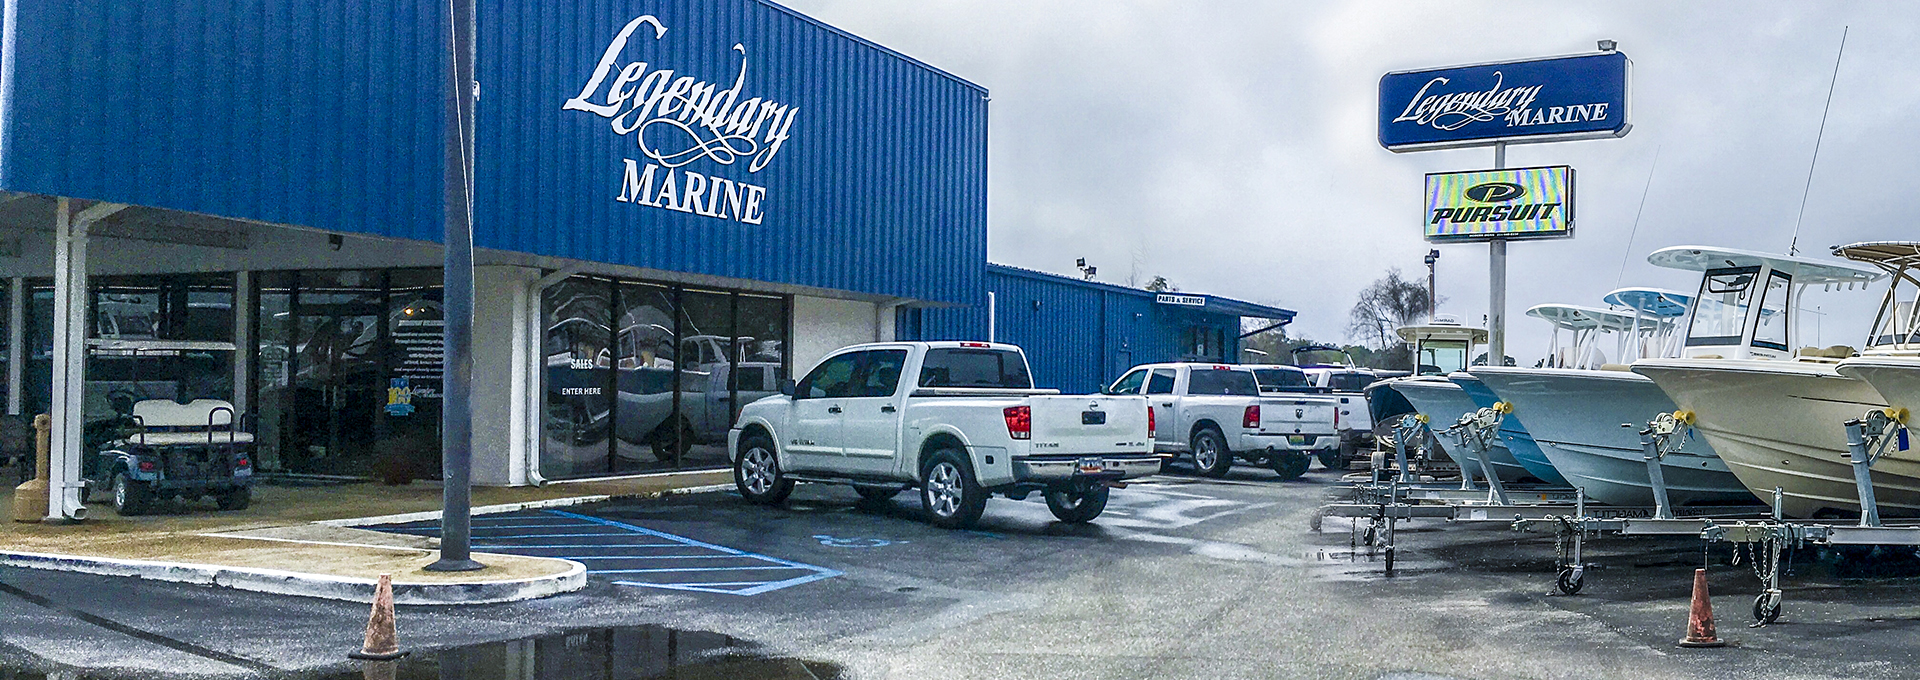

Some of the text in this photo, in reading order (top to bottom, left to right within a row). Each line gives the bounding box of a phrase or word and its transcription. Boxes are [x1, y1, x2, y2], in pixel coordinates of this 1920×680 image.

[563, 15, 799, 172] Legendary
[1392, 71, 1543, 130] Legendary
[1507, 103, 1609, 127] MARINE
[617, 158, 766, 225] MARINE
[1431, 203, 1561, 224] PURSUIT
[1158, 295, 1175, 303] PARTS
[570, 358, 594, 369] SALES
[562, 387, 601, 395] ENTER HERE
